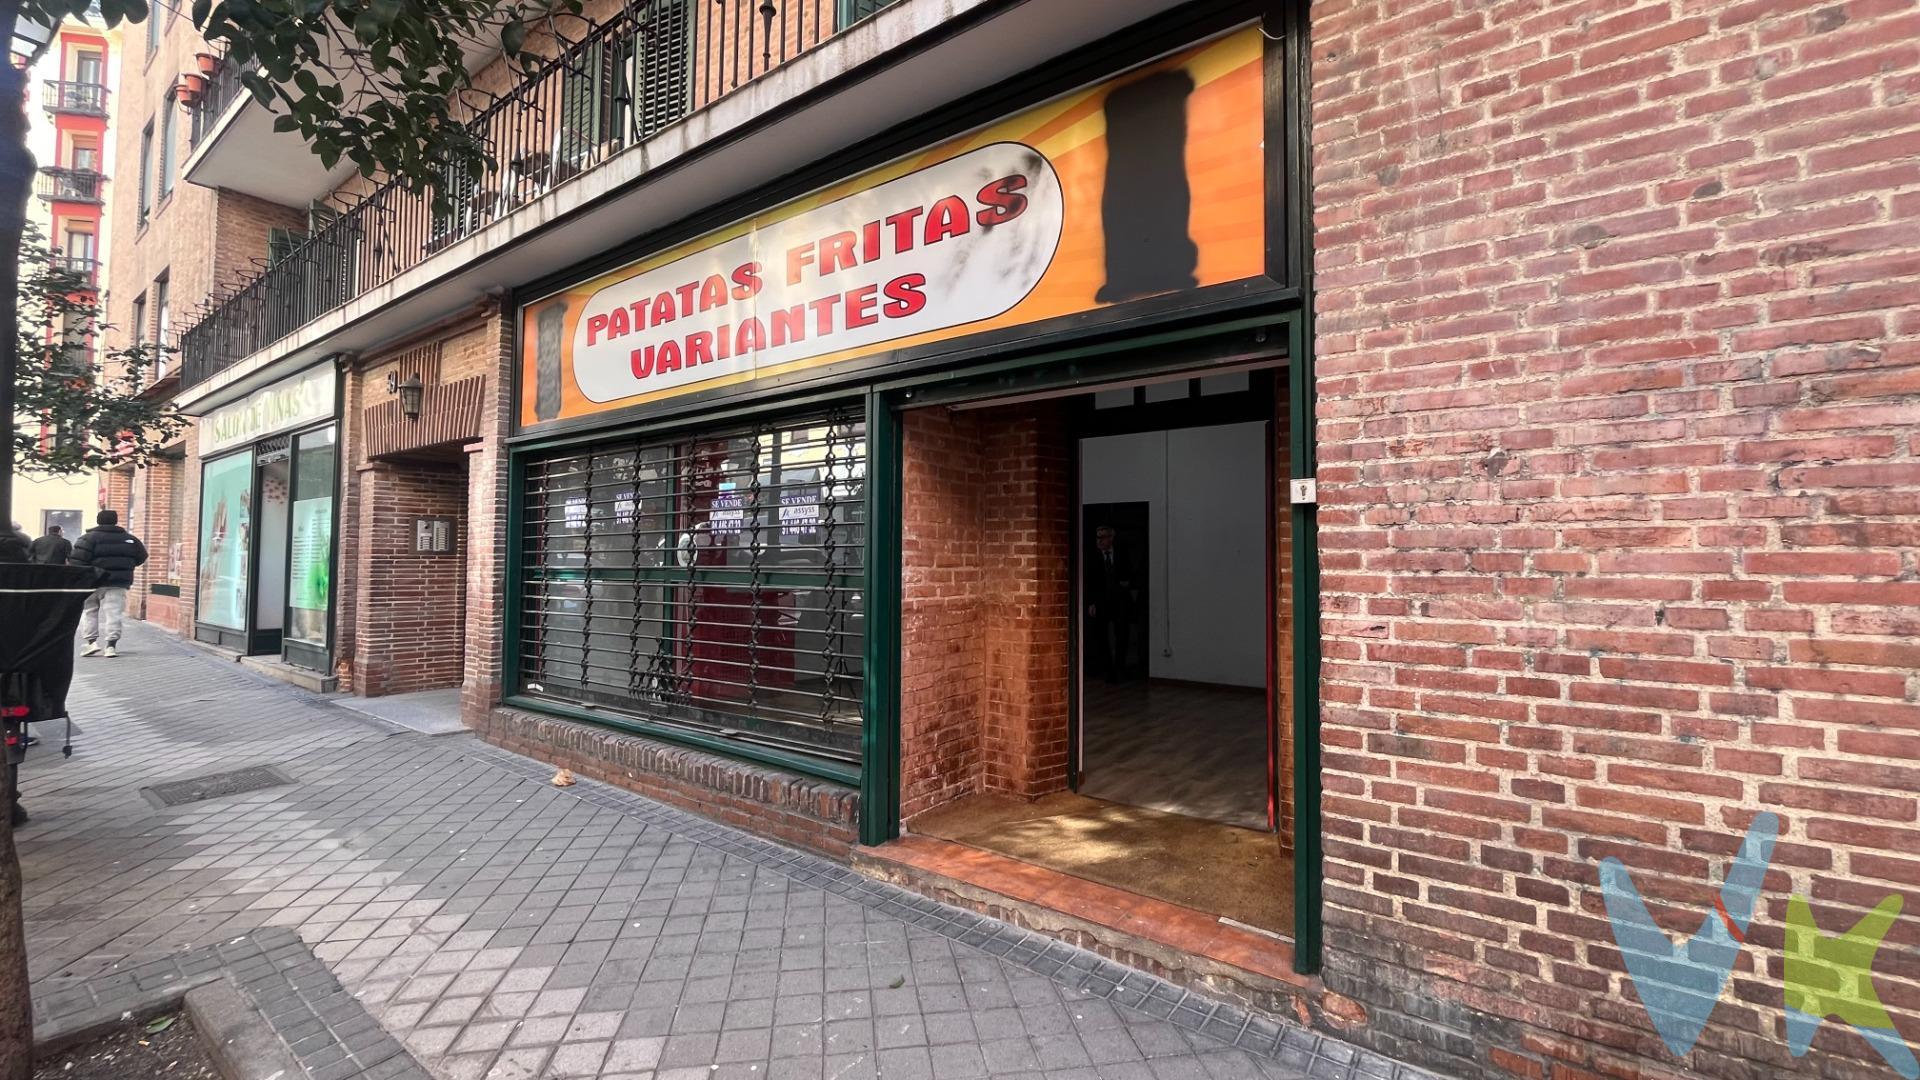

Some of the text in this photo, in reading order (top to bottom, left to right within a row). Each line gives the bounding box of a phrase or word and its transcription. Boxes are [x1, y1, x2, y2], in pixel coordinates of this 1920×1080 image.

[587, 174, 1029, 347] PATATAS FRITAS
[631, 272, 927, 380] VARIANTES
[712, 499, 742, 508] SE VENDE
[791, 495, 817, 505] VENDE
